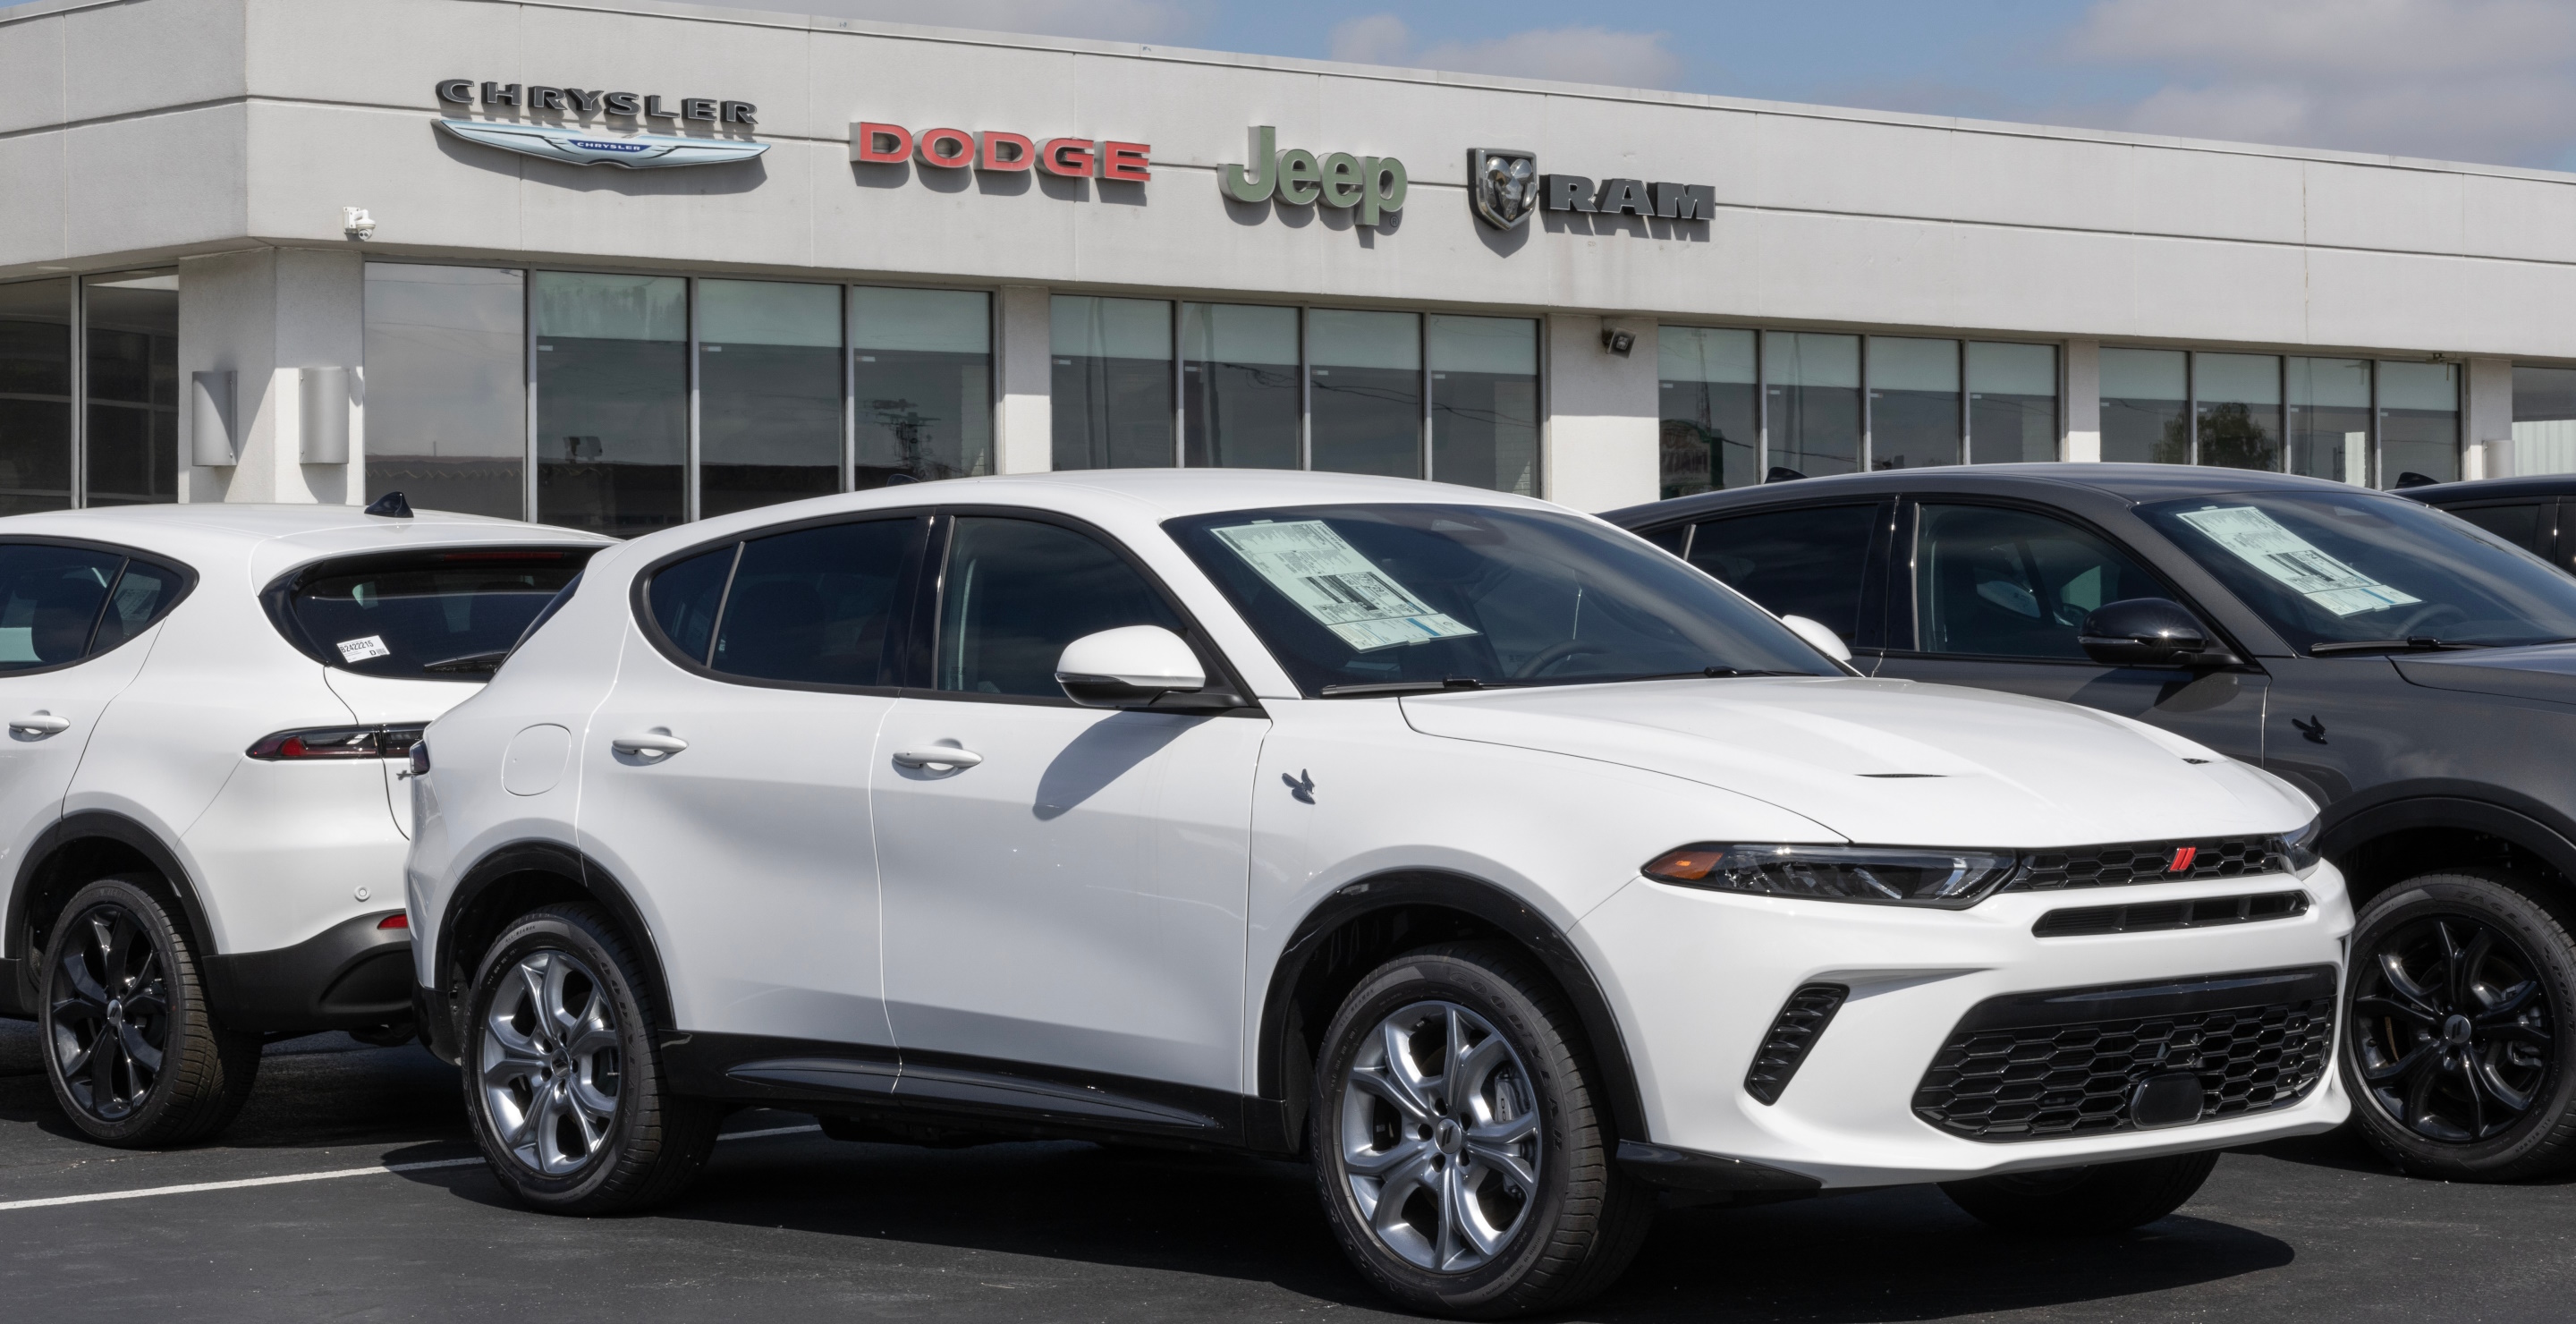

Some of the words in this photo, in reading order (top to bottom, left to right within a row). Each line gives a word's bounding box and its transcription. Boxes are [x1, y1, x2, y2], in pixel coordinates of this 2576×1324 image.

[436, 79, 758, 124] CHRYSLER
[577, 141, 641, 151] CHRYSLER
[850, 122, 1151, 182] DODGE
[1216, 125, 1408, 226] Jeep
[1538, 174, 1716, 220] RAM
[1448, 972, 1563, 1152] GOODYEAR
